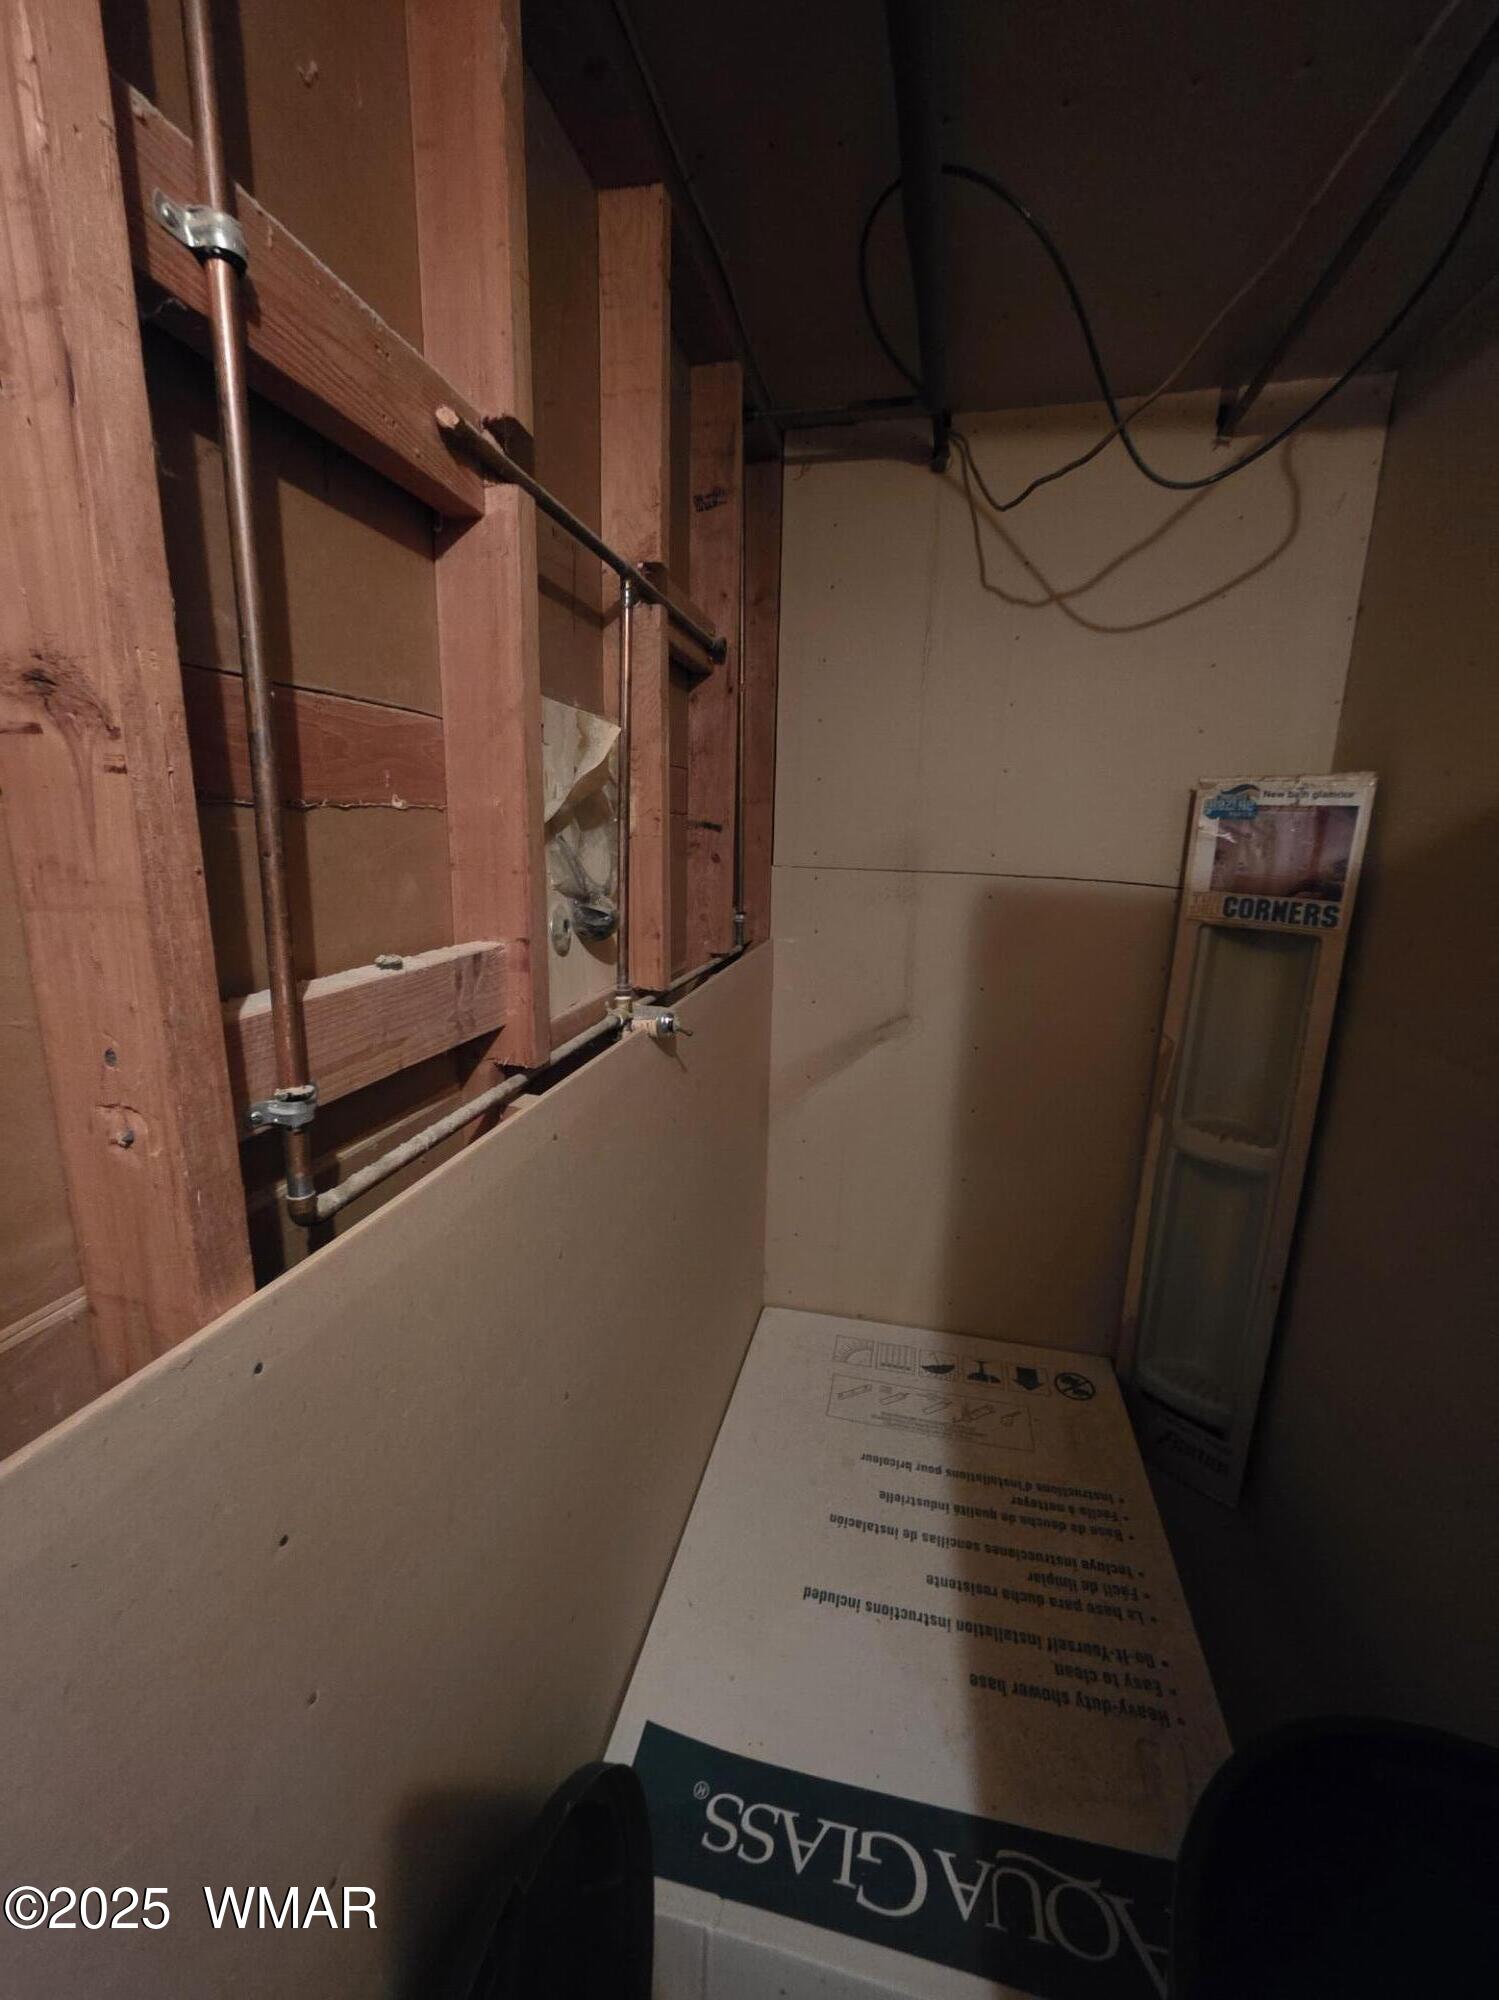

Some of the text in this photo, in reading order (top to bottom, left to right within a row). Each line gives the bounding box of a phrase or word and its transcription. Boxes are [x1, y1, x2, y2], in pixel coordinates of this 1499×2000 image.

[1263, 790, 1285, 799] New
[1222, 896, 1339, 928] CORNERS
[860, 1453, 912, 1472] bricoleur
[915, 1461, 942, 1476] pour
[878, 1490, 949, 1514] industrielle
[1036, 1482, 1113, 1505] Instructions
[953, 1504, 997, 1522] qualité
[1001, 1513, 1016, 1525] de
[1070, 1523, 1086, 1536] de
[829, 1514, 1132, 1577] Incluye instrucciones sencillas de instalación
[925, 1574, 997, 1598] resistente
[1026, 1572, 1076, 1590] limpiar
[1081, 1580, 1098, 1594] de
[802, 1584, 861, 1616] included
[1002, 1589, 1044, 1607] ducha
[1049, 1597, 1081, 1613] para
[864, 1599, 952, 1633] instructions
[1087, 1603, 1122, 1621] base
[956, 1620, 1042, 1650] installation
[1054, 1664, 1162, 1697] Easy to clean
[969, 1673, 1171, 1728] Heavy-duty shower base
